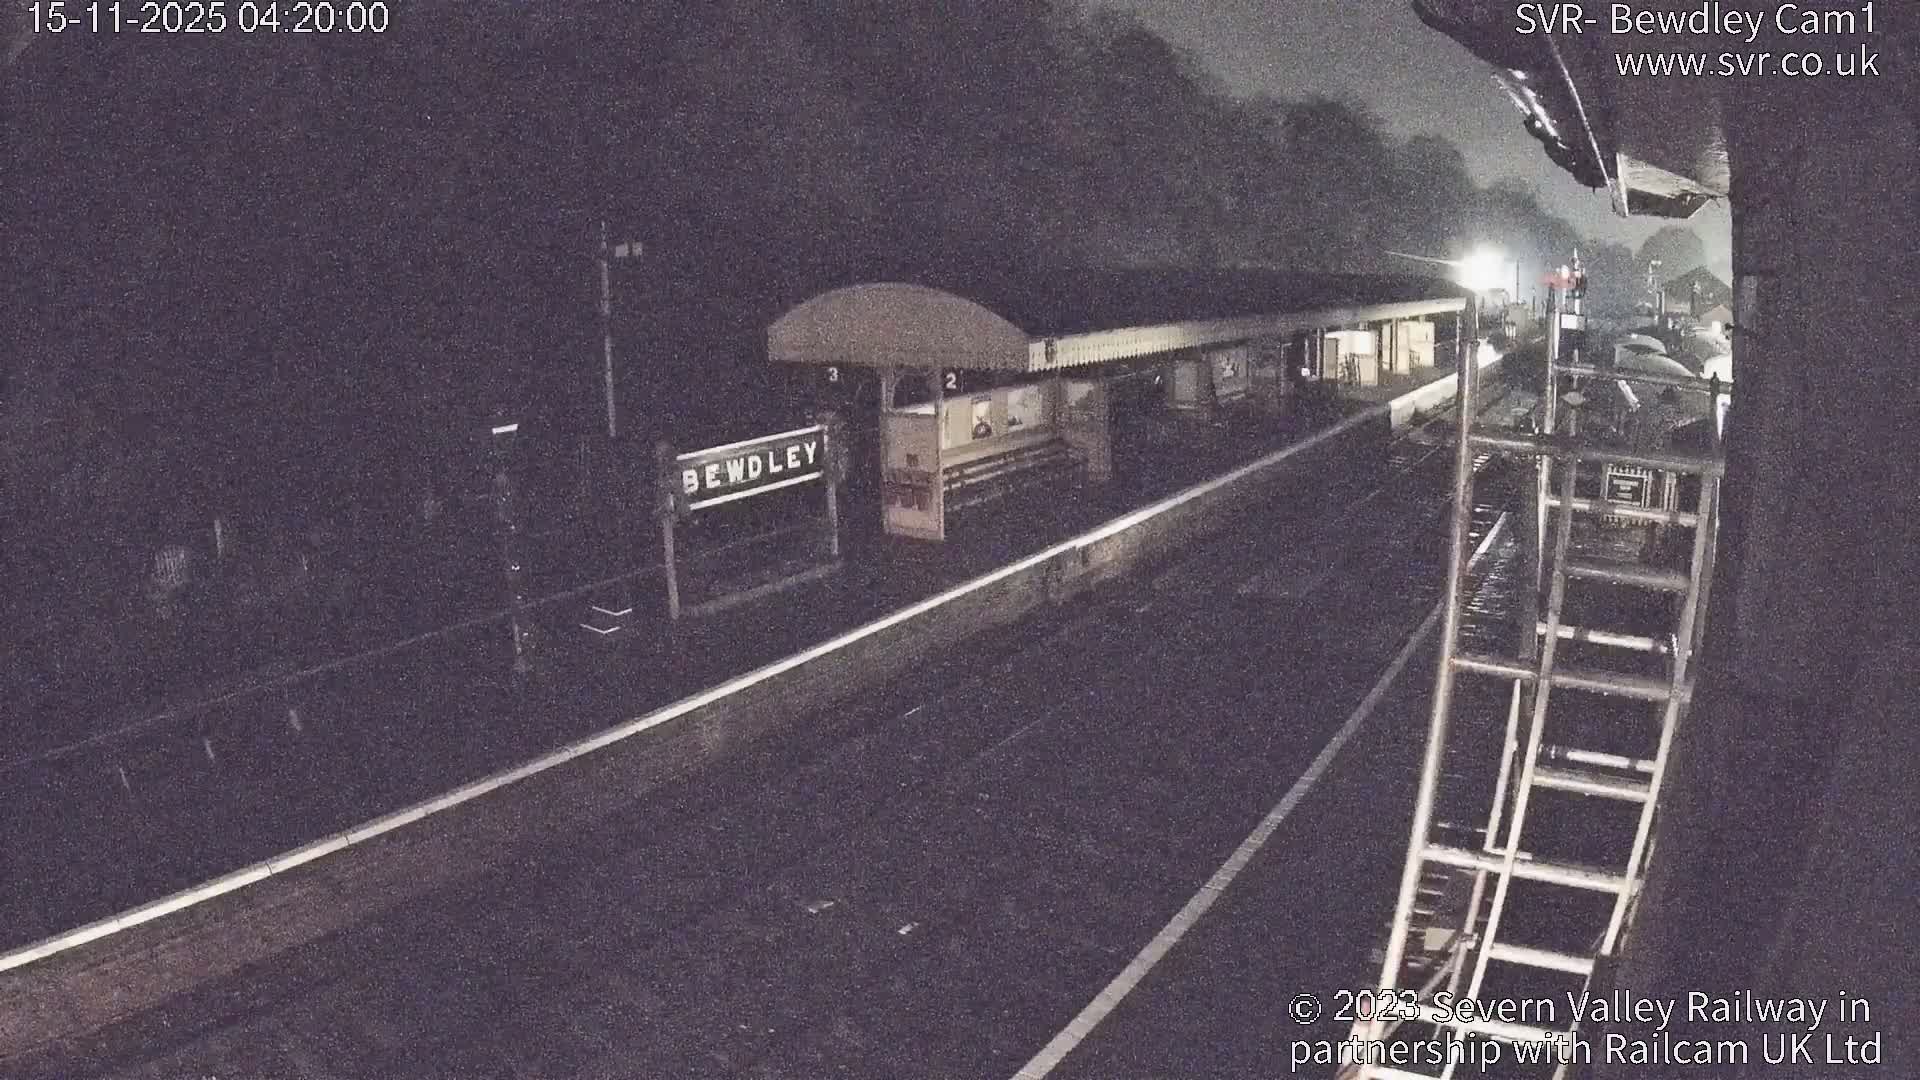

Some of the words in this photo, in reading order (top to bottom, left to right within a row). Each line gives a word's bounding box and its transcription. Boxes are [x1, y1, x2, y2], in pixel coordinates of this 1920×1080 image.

[828, 366, 839, 382] 3
[945, 372, 957, 390] 2
[682, 441, 817, 495] BEWDLEY
